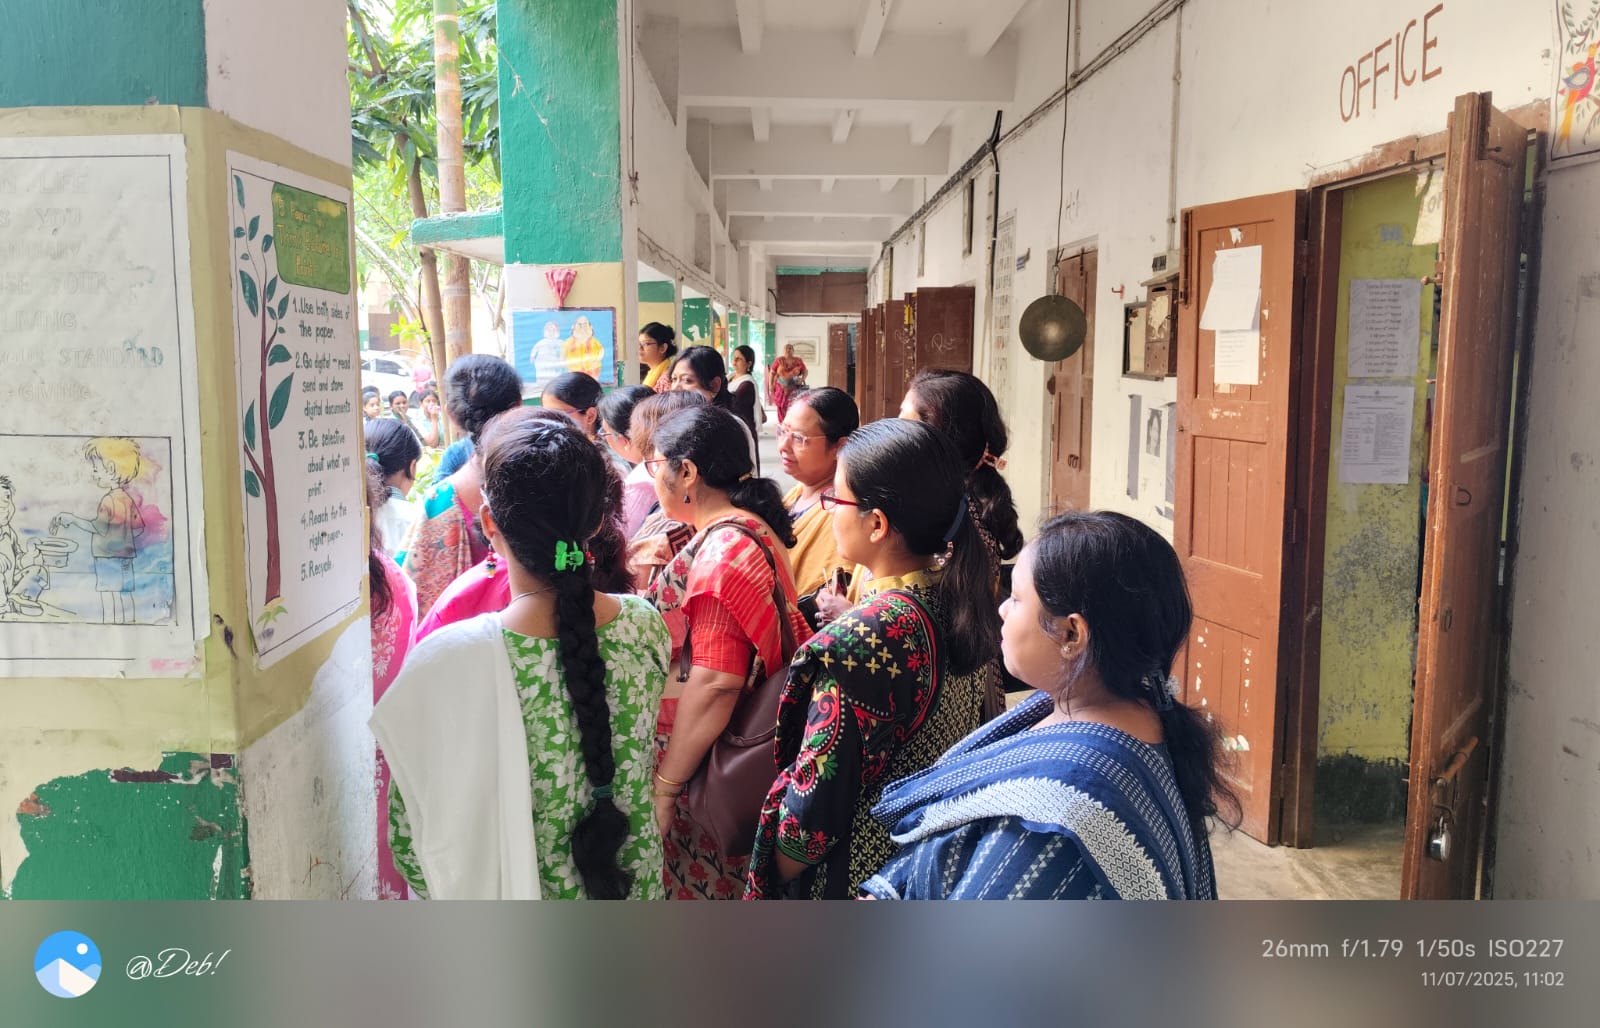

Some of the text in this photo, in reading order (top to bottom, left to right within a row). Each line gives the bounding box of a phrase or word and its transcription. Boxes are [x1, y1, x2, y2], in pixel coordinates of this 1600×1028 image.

[1340, 3, 1443, 122] OFFICE
[315, 300, 329, 319] both
[331, 304, 343, 319] sides
[298, 320, 335, 343] the paper.
[314, 352, 331, 374] digital
[337, 353, 351, 369] read
[302, 376, 344, 393] send and store
[304, 398, 351, 420] digital documents
[322, 428, 345, 447] selective
[308, 453, 350, 473] about what you
[339, 502, 347, 517] the
[309, 530, 325, 552] right
